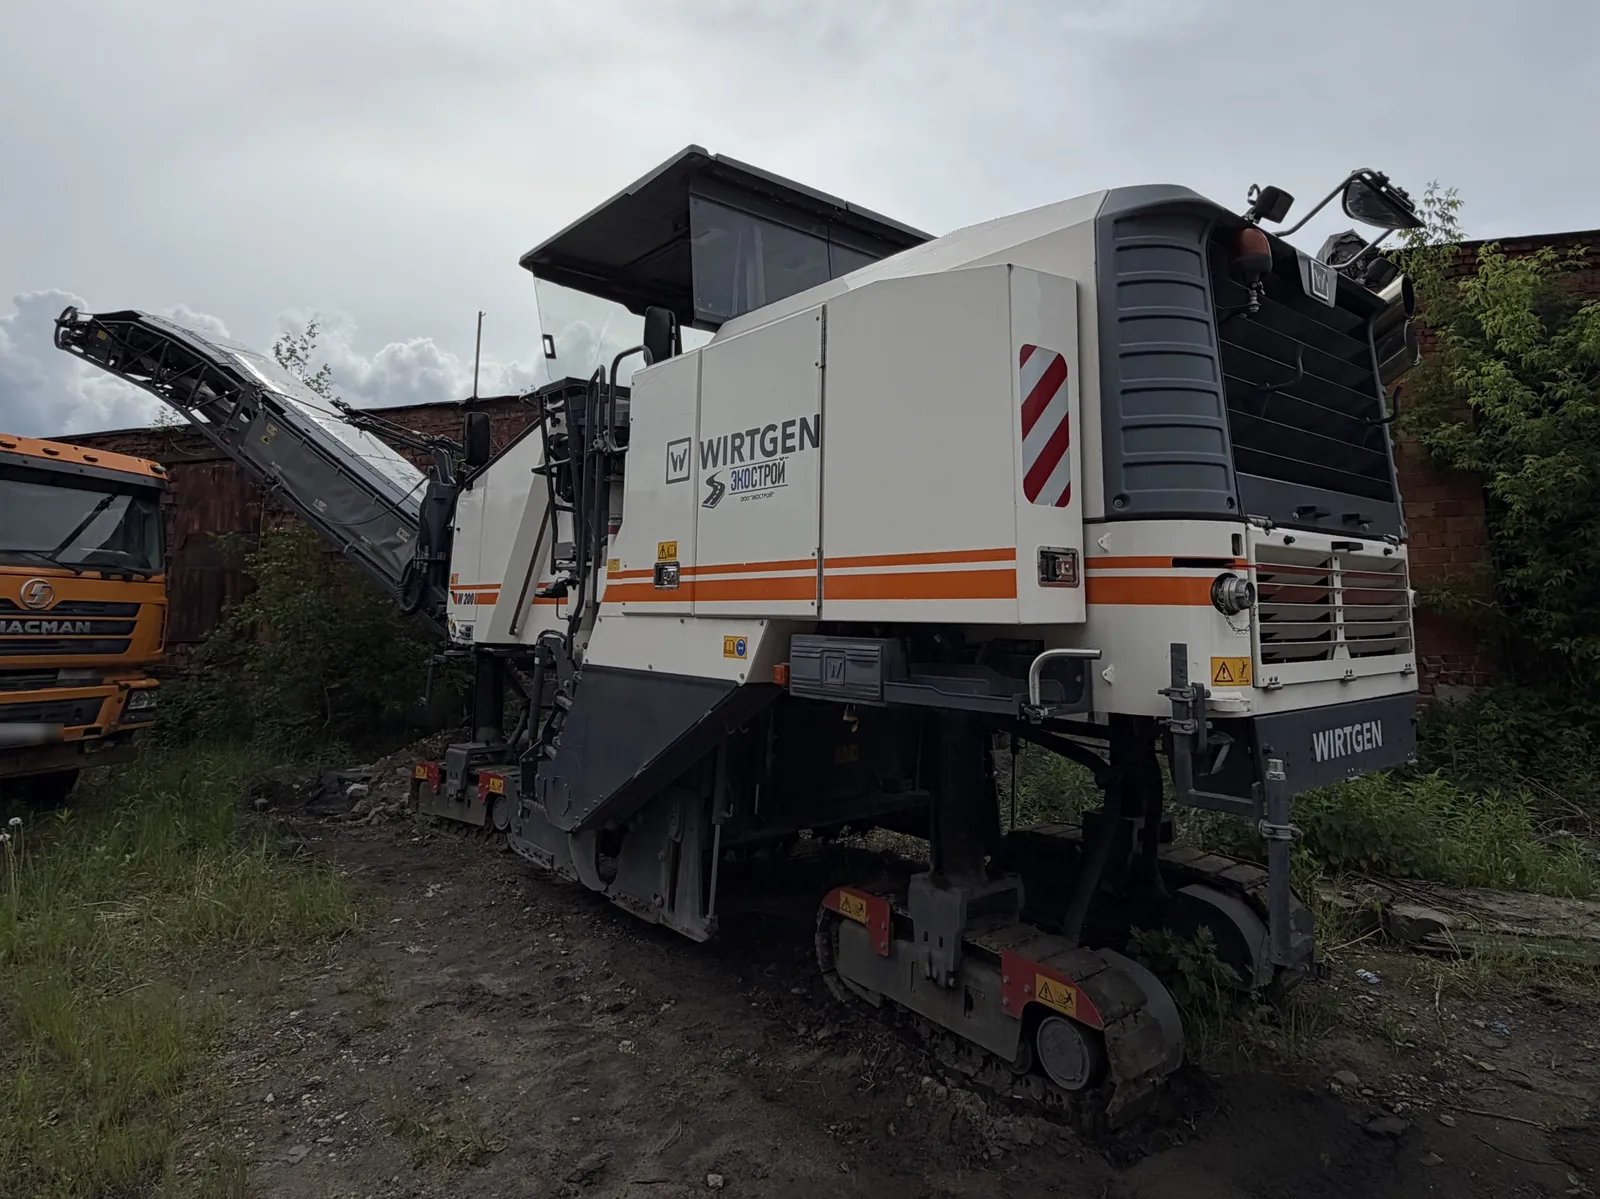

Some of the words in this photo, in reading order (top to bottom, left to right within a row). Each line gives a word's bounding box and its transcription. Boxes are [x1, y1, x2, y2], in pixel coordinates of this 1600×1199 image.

[700, 413, 820, 470] WIRTGEN
[731, 457, 786, 491] ЭКОСТРОЙ
[1313, 720, 1383, 762] WIRTGEN
